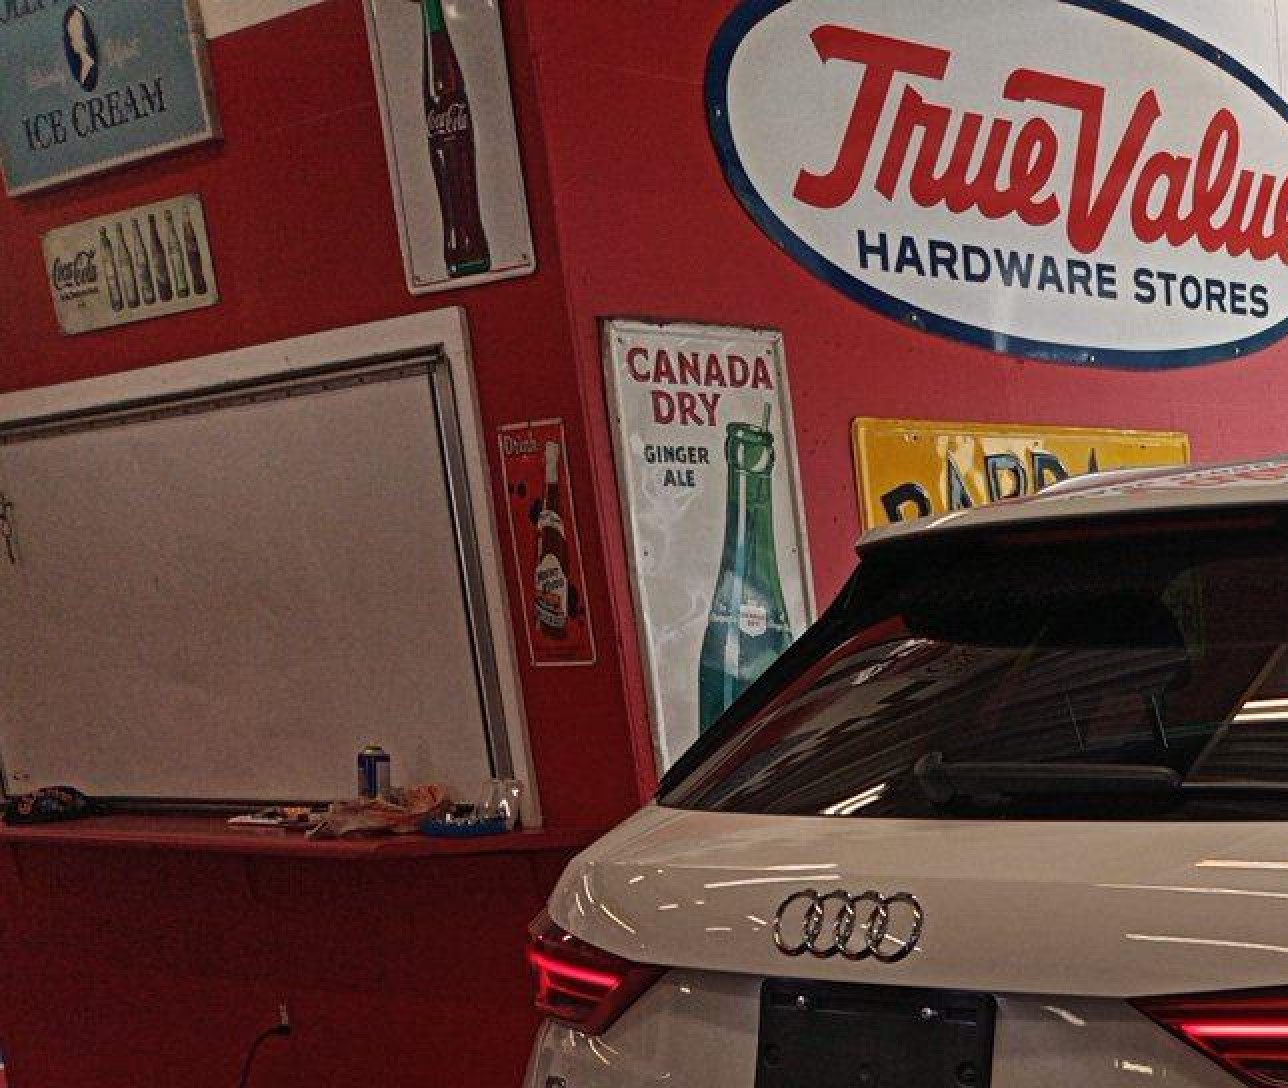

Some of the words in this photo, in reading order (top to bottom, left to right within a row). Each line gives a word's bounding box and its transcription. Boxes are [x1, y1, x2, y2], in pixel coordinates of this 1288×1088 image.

[22, 110, 67, 151] ICE
[71, 77, 167, 138] CREAM
[857, 229, 1117, 299] HARDWARE
[1133, 267, 1269, 319] STORES
[626, 347, 774, 390] CANADA
[651, 389, 720, 427] DRY
[643, 444, 710, 464] GINGER
[663, 469, 696, 487] ALE
